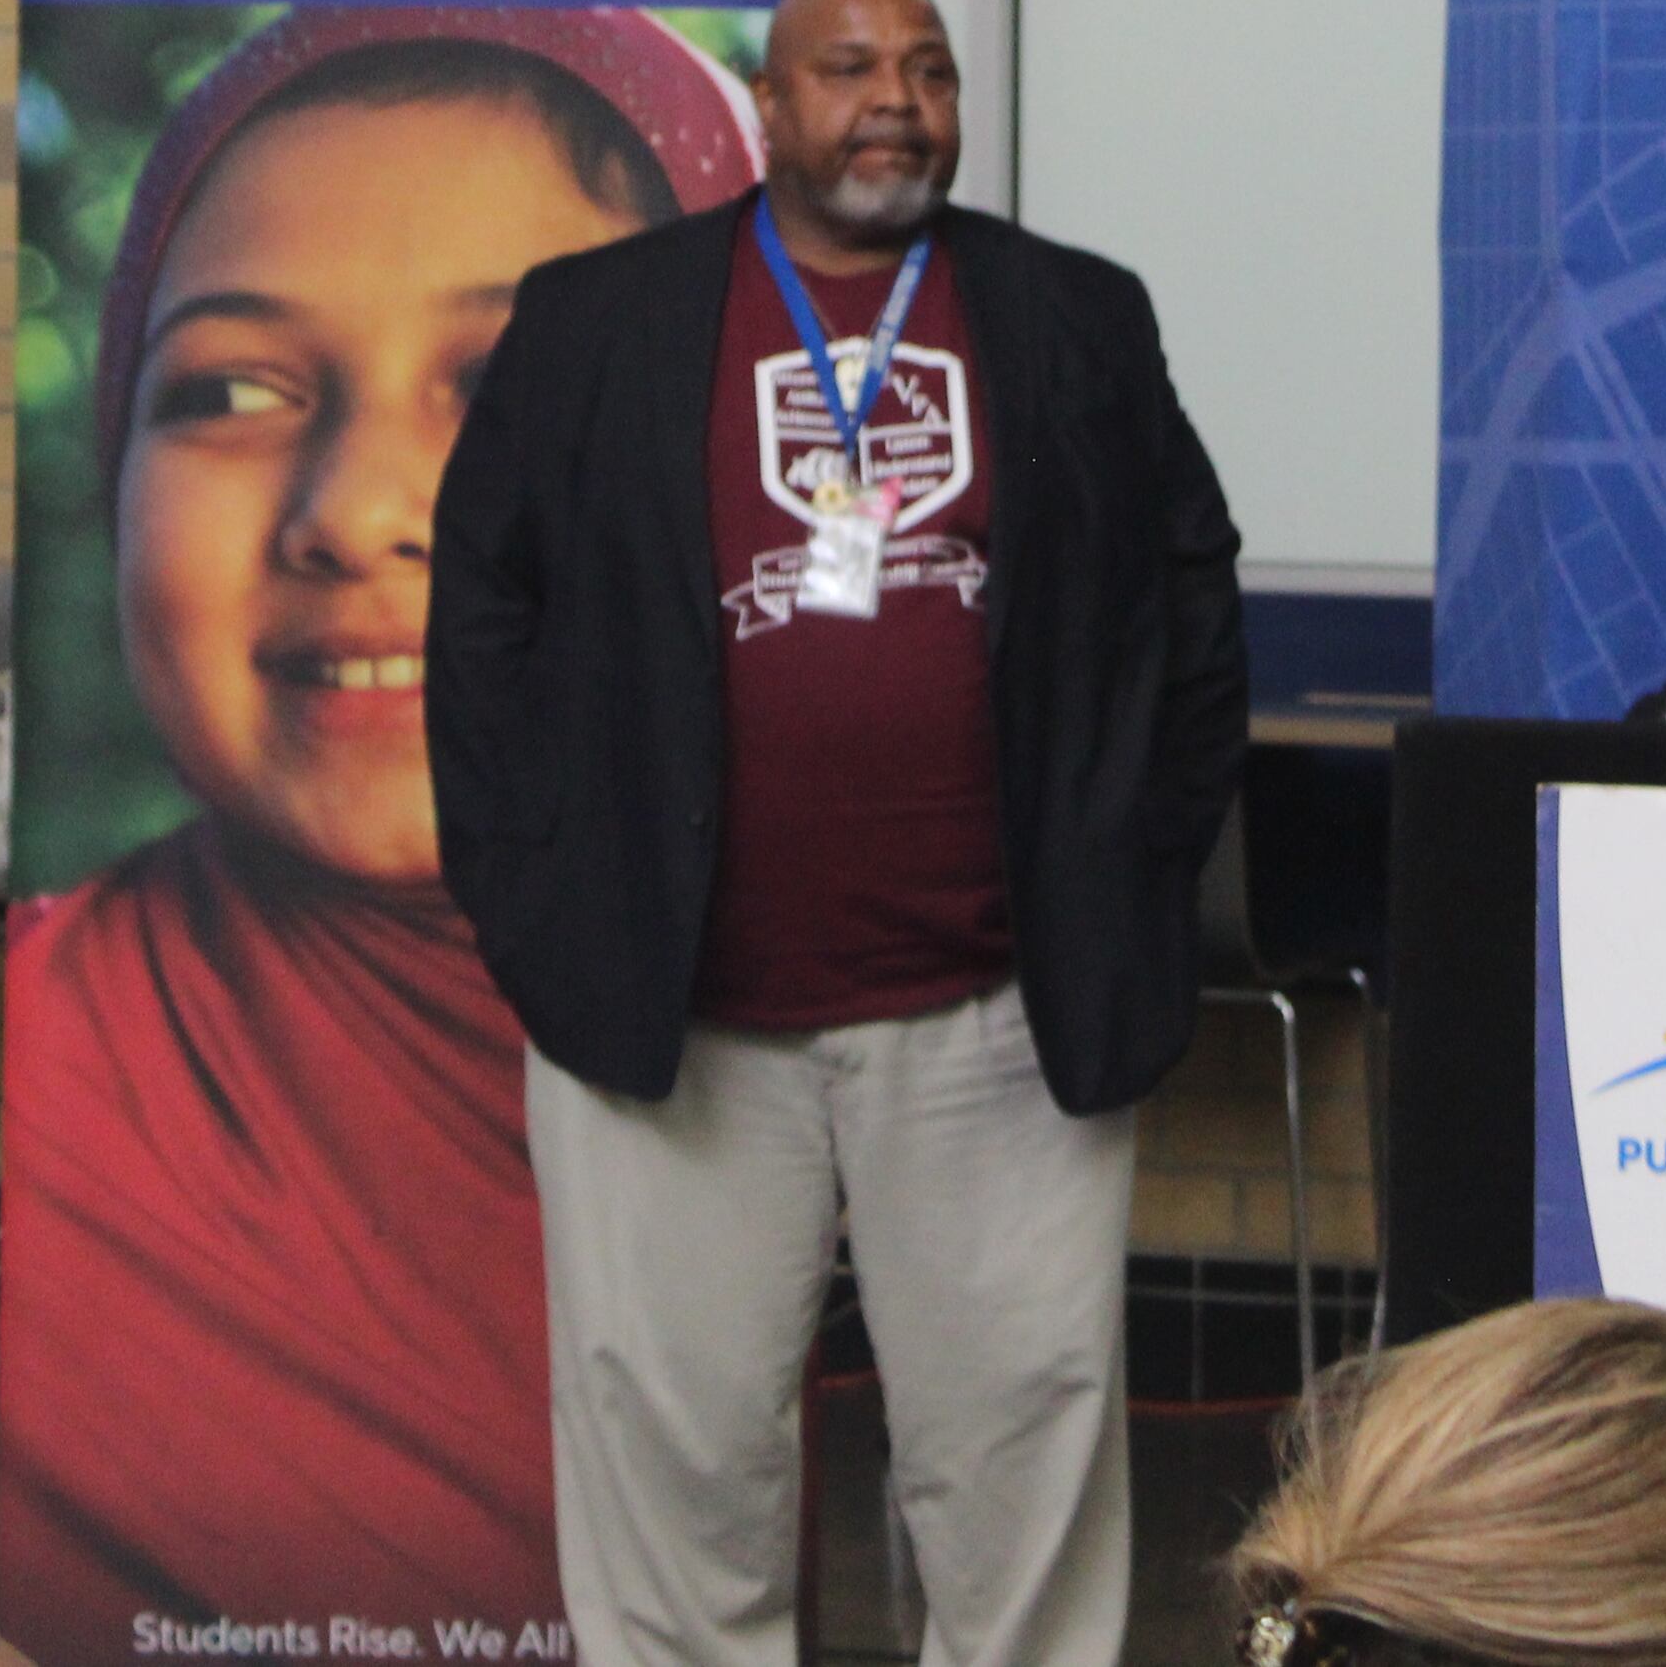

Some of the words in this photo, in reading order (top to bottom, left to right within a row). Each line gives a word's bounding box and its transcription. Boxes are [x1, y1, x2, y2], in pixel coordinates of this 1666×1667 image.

[132, 1613, 318, 1657] Students
[329, 1617, 424, 1660] Rise.
[433, 1620, 505, 1659] We
[513, 1619, 568, 1659] All
